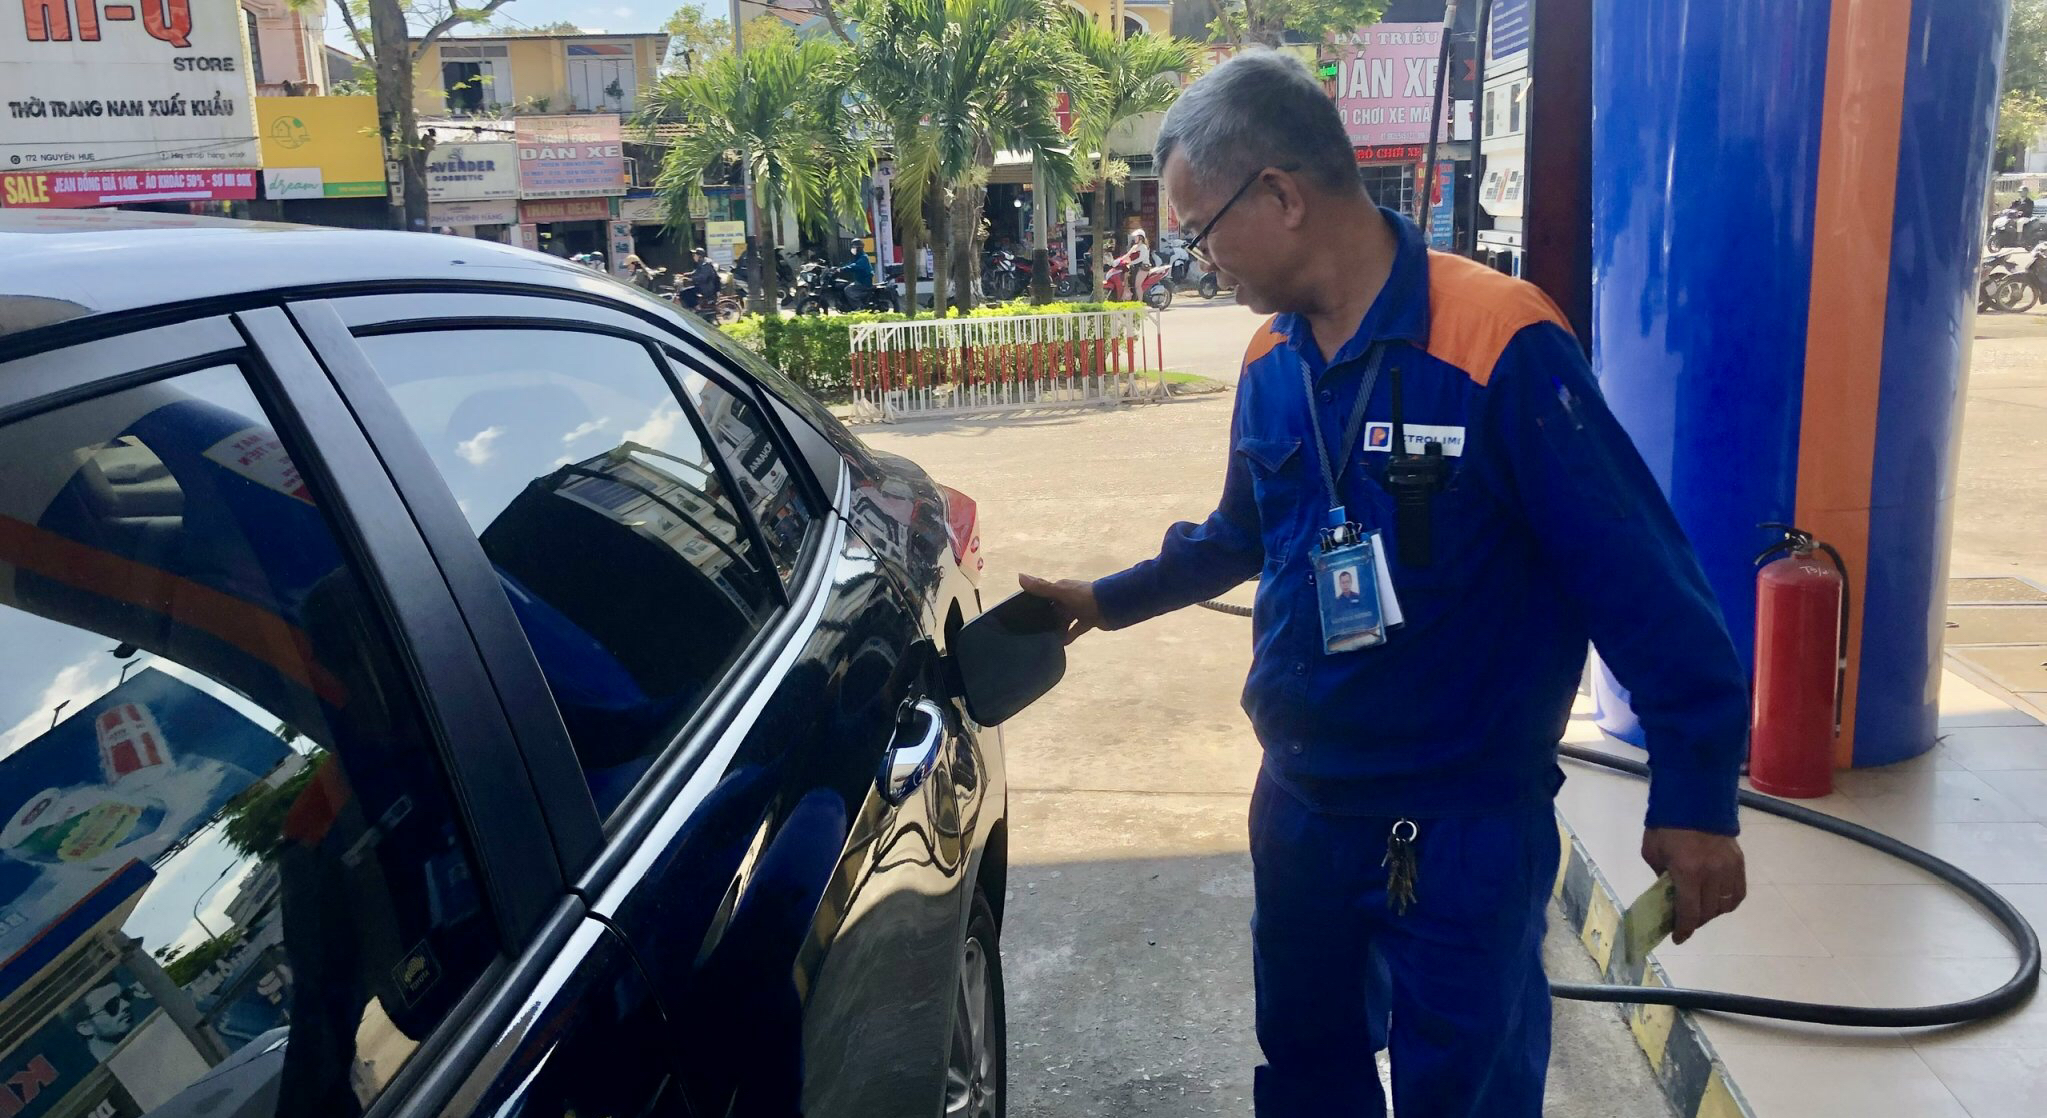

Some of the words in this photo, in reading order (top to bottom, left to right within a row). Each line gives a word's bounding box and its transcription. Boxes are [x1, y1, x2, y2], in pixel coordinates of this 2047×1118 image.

[173, 56, 235, 72] STORE
[1338, 50, 1393, 99] DÁN
[1403, 58, 1441, 98] XE
[8, 96, 47, 118] THỜI
[49, 100, 103, 118] TRANG
[106, 100, 144, 117] NAM
[148, 92, 187, 117] XUẤT
[191, 90, 234, 117] KHẨU
[1353, 106, 1385, 125] CHƠI
[1389, 107, 1405, 124] XE
[1410, 103, 1434, 123] MÁ
[25, 154, 37, 162] 172
[586, 145, 620, 158] XE
[425, 160, 496, 173] AVENDER
[4, 175, 51, 204] SALE
[54, 177, 77, 193] JEAN
